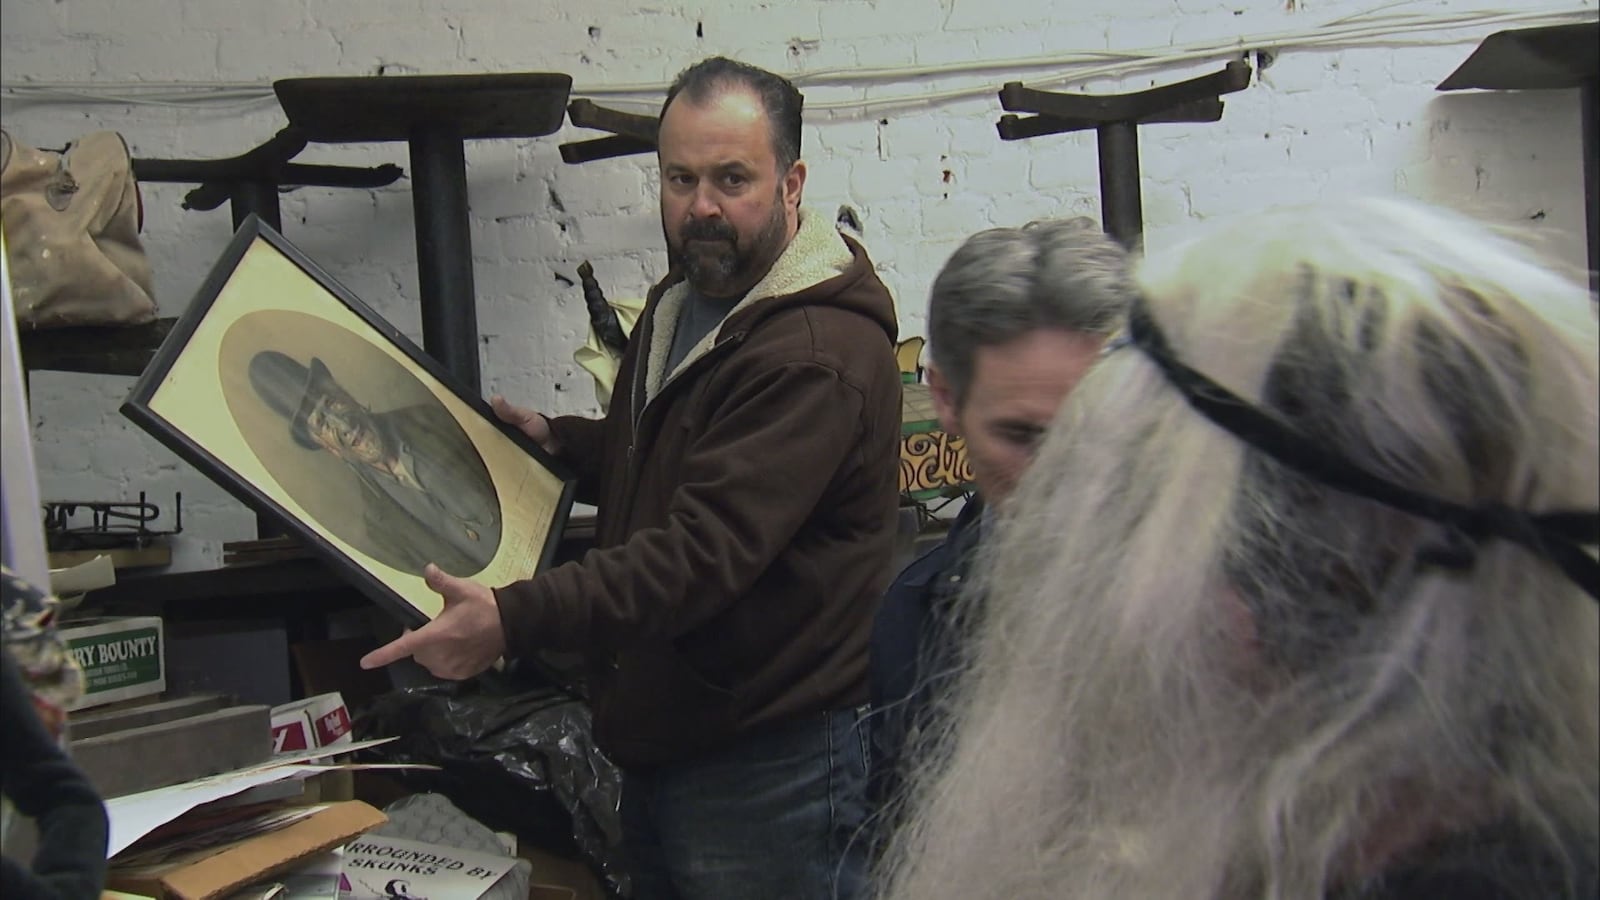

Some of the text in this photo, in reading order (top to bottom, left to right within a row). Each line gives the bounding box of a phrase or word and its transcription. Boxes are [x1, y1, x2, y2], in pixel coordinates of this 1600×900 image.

[97, 635, 156, 664] BOUNTY
[345, 842, 498, 880] RROUNDED BY
[348, 858, 439, 875] SKUNKS
